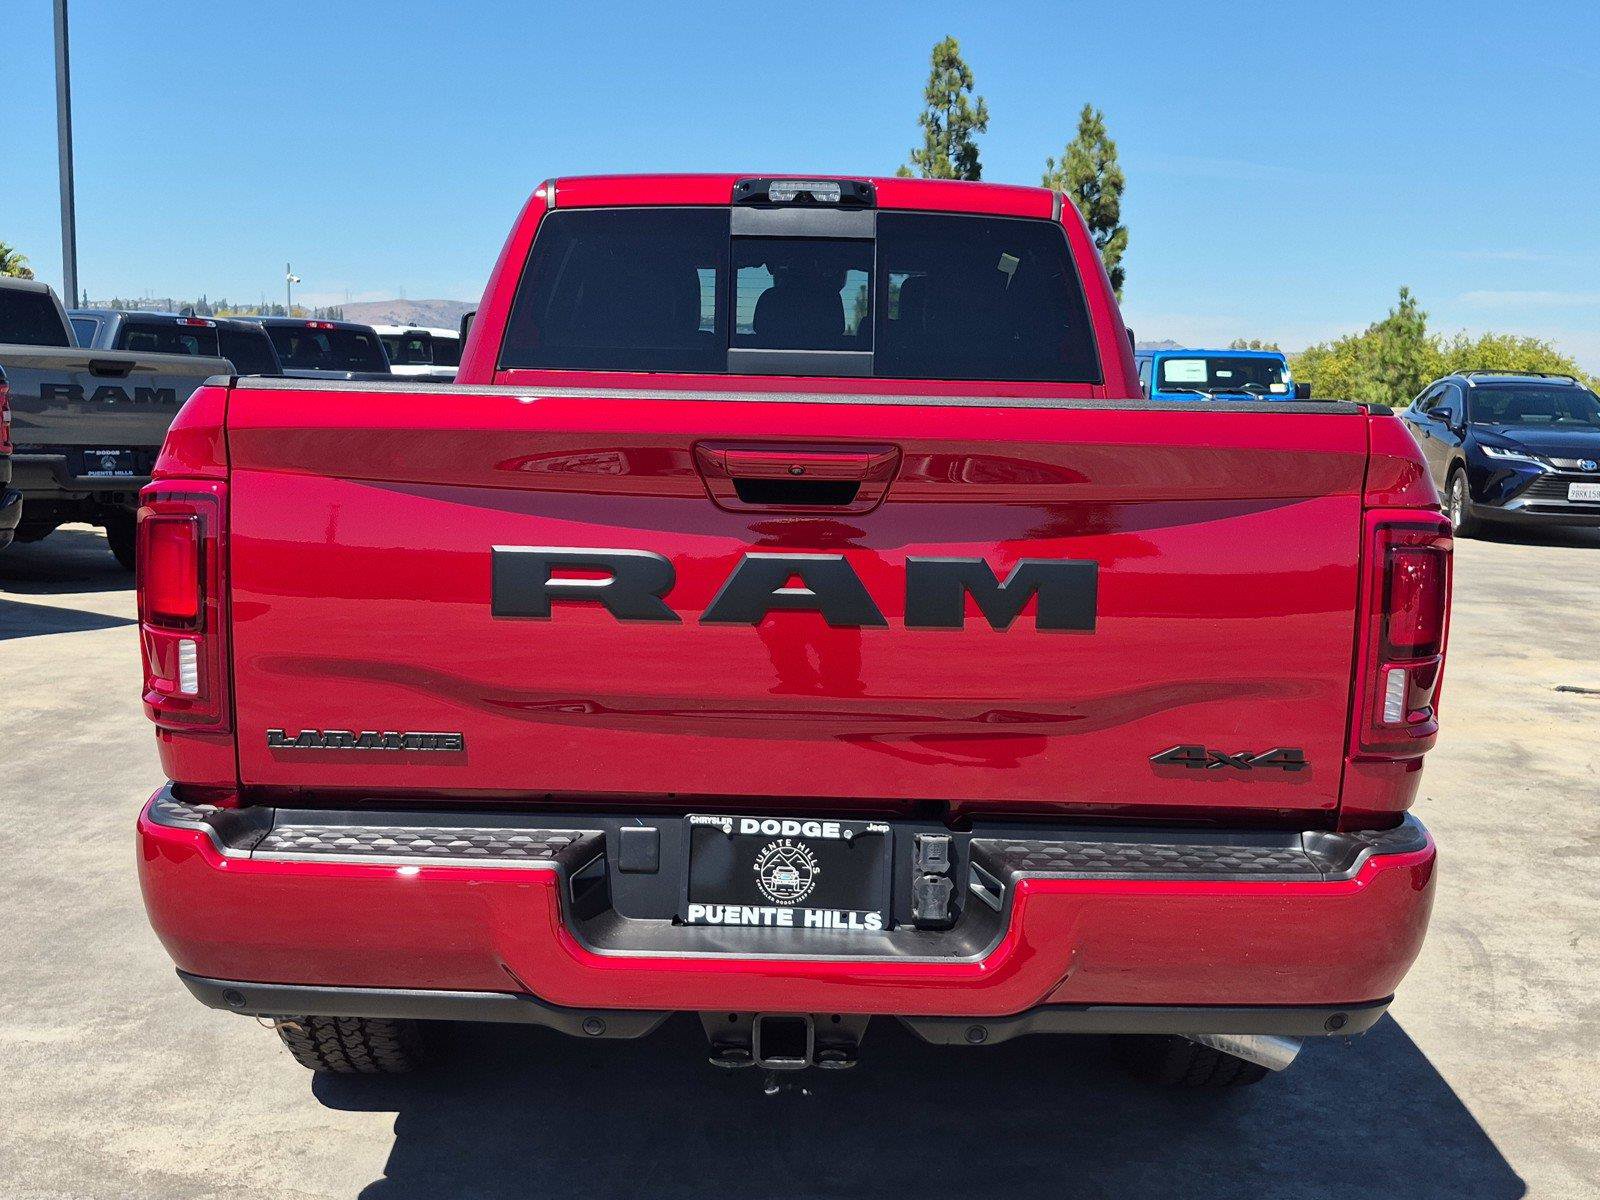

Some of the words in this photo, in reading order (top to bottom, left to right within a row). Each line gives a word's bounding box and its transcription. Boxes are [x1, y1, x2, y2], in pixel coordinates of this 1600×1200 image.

[40, 383, 176, 403] RAM
[491, 544, 1099, 634] RAM
[267, 728, 464, 751] LARAMIE
[689, 815, 733, 826] CHRYSLER
[740, 818, 841, 839] DODGE
[866, 823, 890, 833] Jeep
[753, 839, 792, 871] PUENTE
[797, 842, 820, 874] HILLS
[688, 904, 794, 927] PUENTE
[804, 909, 883, 931] HILLS
